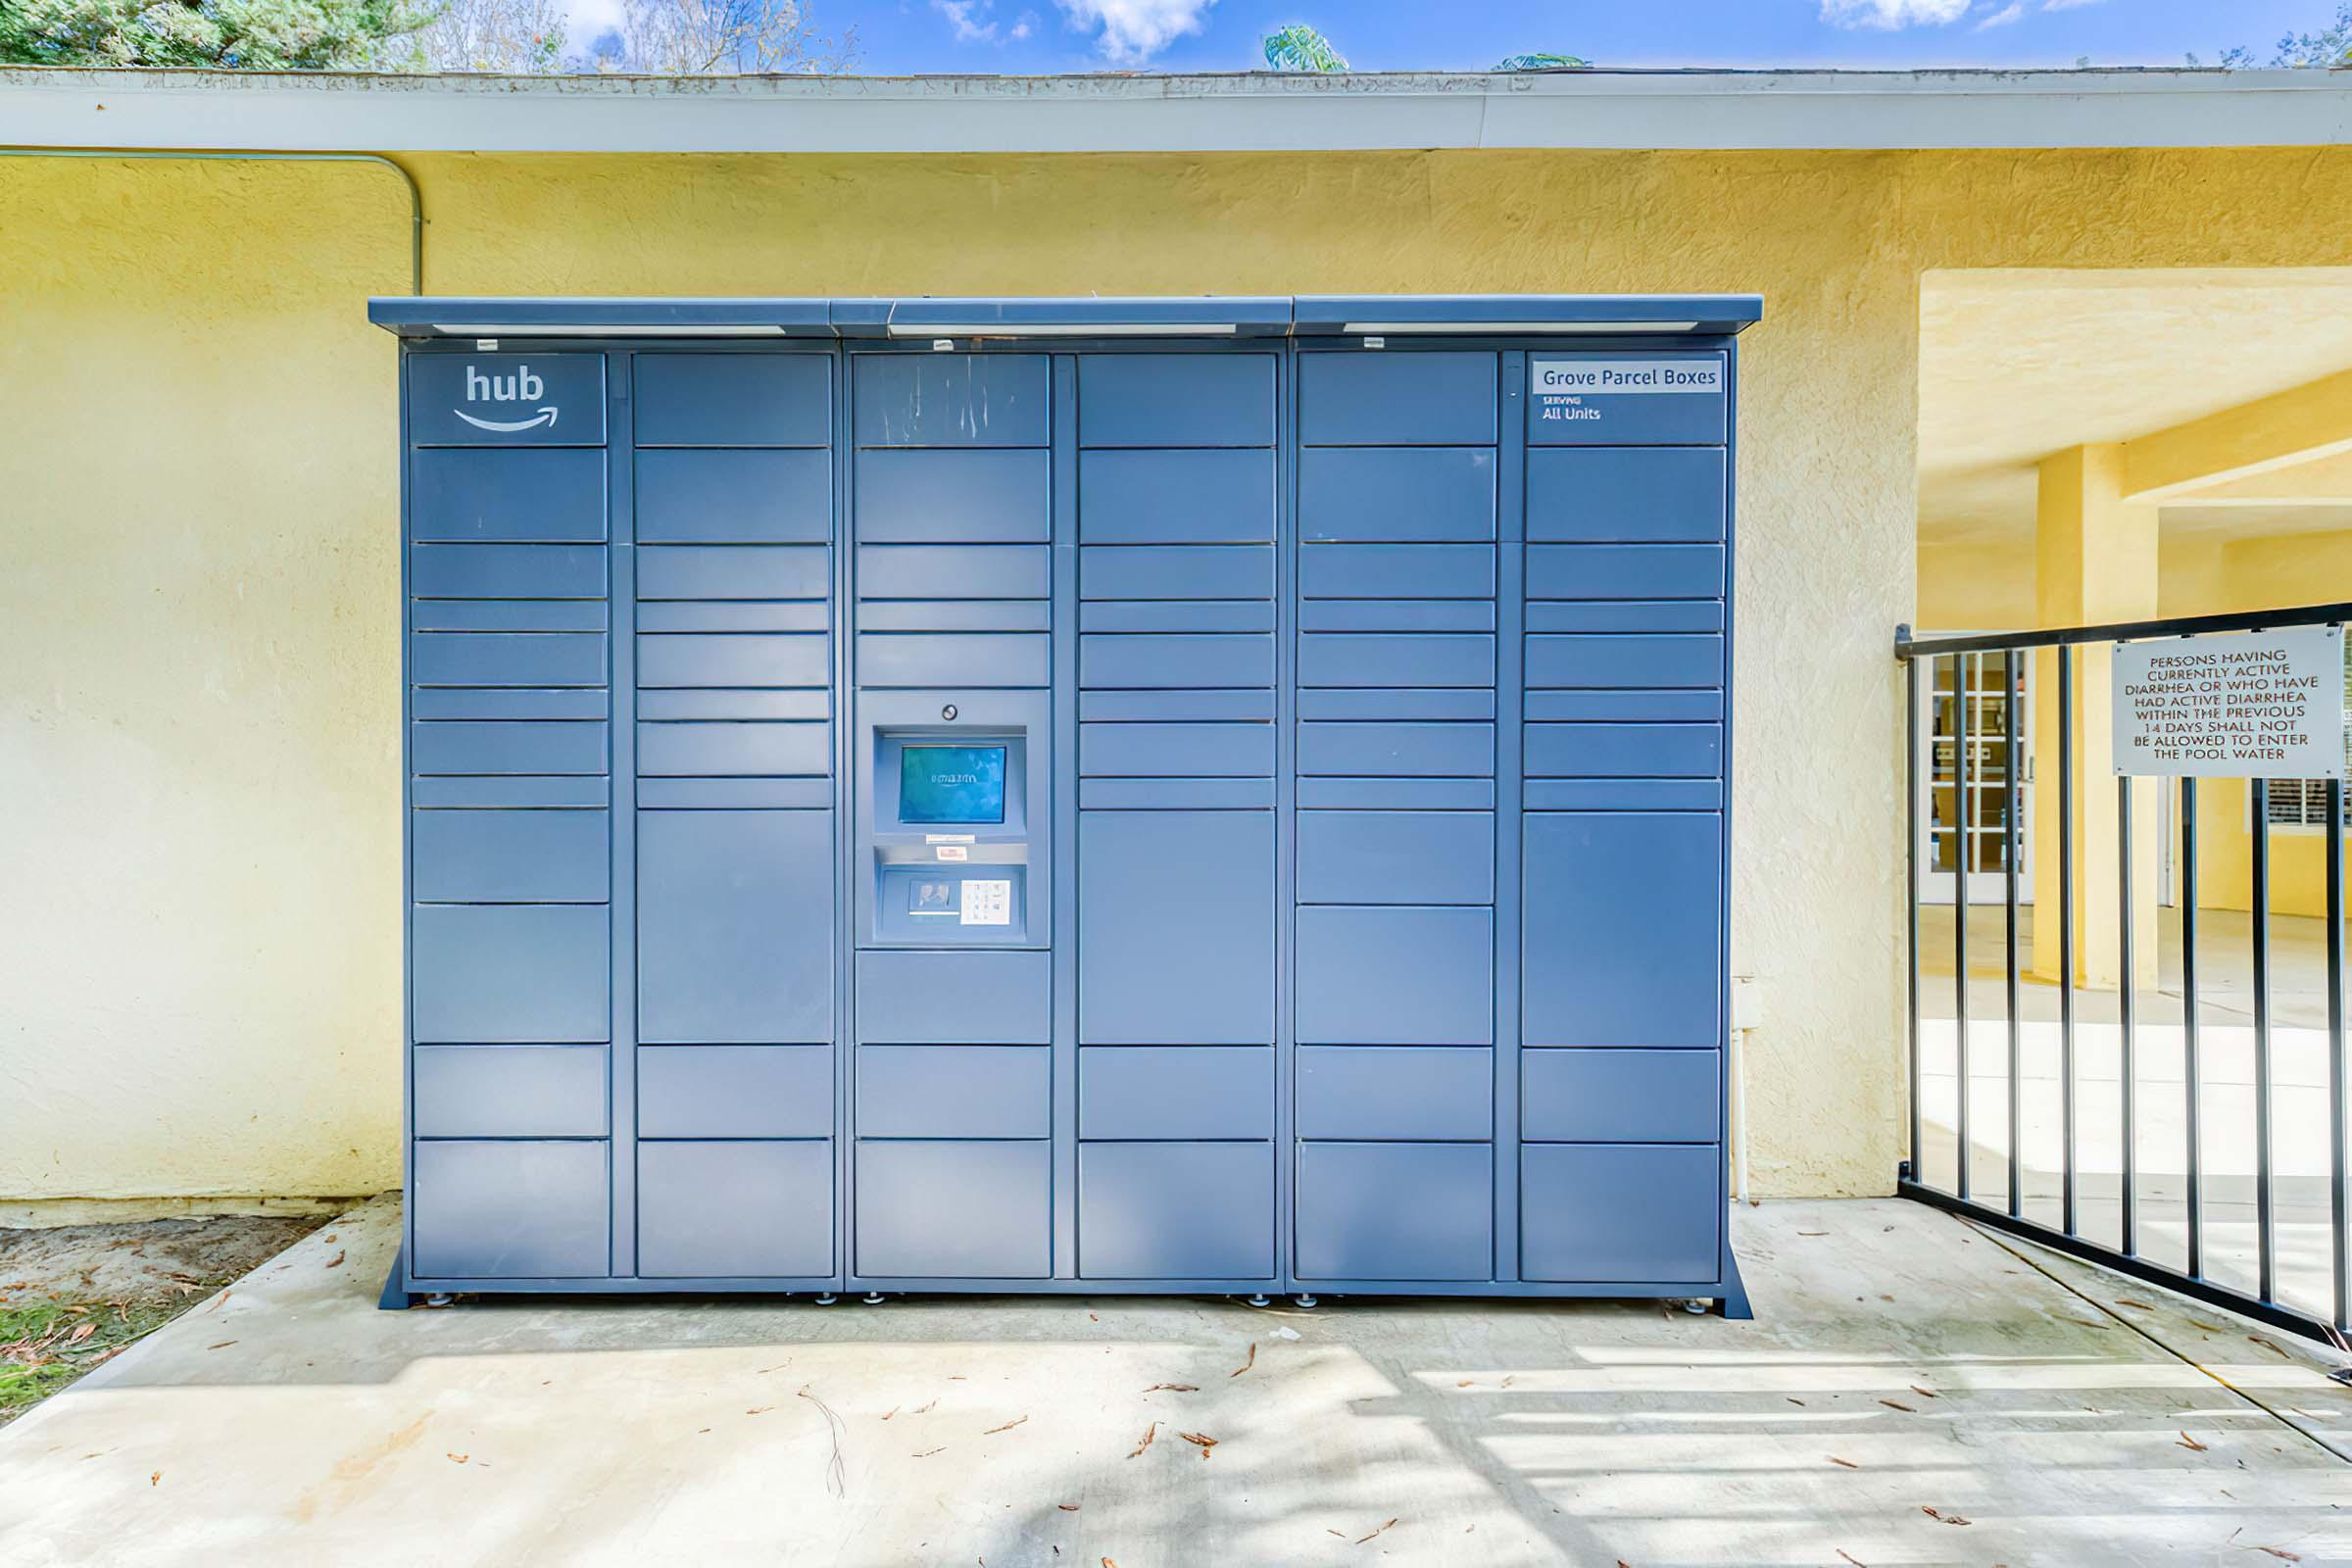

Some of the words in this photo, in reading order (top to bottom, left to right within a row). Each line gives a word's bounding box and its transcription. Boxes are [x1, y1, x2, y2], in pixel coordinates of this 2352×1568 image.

[466, 366, 544, 400] hub
[1544, 369, 1595, 385] Grove
[1602, 369, 1657, 385] Parcel
[1664, 369, 1716, 384] Boxes
[1543, 408, 1561, 419] All
[1565, 408, 1601, 419] Units
[2150, 655, 2217, 668] PERSONS
[2222, 650, 2286, 663] HAVING
[2148, 667, 2230, 682] CURRENTLY
[2235, 663, 2290, 677] ACTIVE
[2126, 683, 2194, 696] DIARRHEA
[2199, 681, 2221, 693] OR
[2227, 678, 2269, 691] WHO
[2275, 676, 2319, 689] HAVE
[2134, 697, 2166, 708] HAD
[2171, 695, 2220, 707] ACTIVE
[2227, 692, 2306, 705] DIARRHEA
[2135, 710, 2188, 720] WITHIN
[2194, 709, 2220, 719] THE
[2227, 706, 2305, 718] PREVIOUS
[2144, 723, 2160, 733] 14
[2166, 722, 2203, 733] DAYS
[2208, 721, 2254, 732] SHALL
[2260, 720, 2297, 731] NOT
[2134, 736, 2149, 747] BE
[2154, 735, 2226, 747] ALLOWED
[2231, 735, 2252, 746] TO
[2258, 734, 2309, 746] ENTER
[2154, 749, 2180, 760] THE
[2185, 749, 2227, 760] POOL
[2232, 749, 2284, 760] WATER
